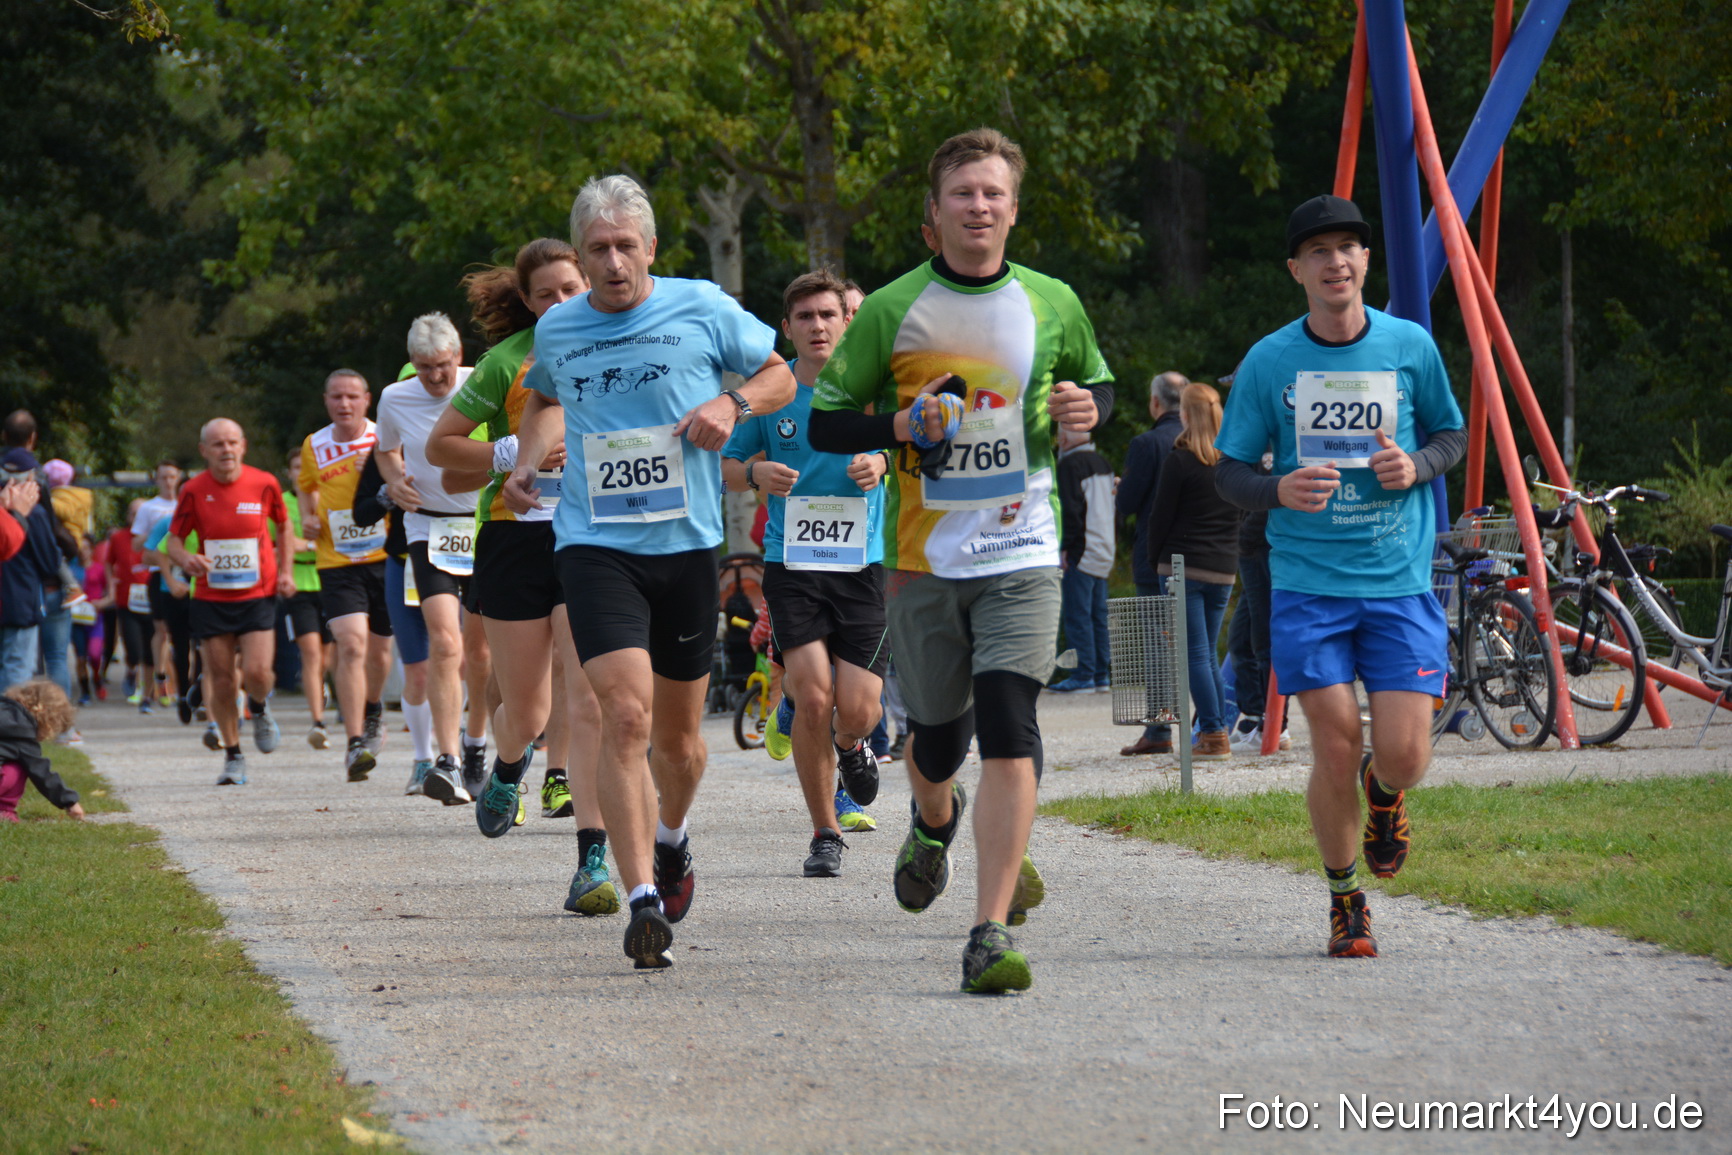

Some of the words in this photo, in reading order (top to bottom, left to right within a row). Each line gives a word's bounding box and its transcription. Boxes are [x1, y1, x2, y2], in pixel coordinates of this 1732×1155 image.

[564, 344, 595, 362] Velburger
[595, 334, 660, 351] Kirchweihtriathlon
[662, 334, 681, 346] 2017
[1334, 381, 1369, 389] BOCK
[1310, 401, 1382, 431] 2320
[616, 436, 652, 448] BOCK
[1323, 440, 1369, 454] Wolfgang
[944, 438, 1010, 471] 766
[599, 455, 669, 490] 2365
[1336, 482, 1361, 501] 18.
[626, 495, 648, 508] Willi
[1332, 500, 1392, 512] Neumarkter
[1332, 511, 1381, 525] Stadtlauf
[796, 519, 855, 543] 2647
[438, 535, 474, 552] 260
[970, 534, 1044, 555] Lammsbräu
[213, 554, 251, 570] 2332
[812, 549, 838, 559] Tobias
